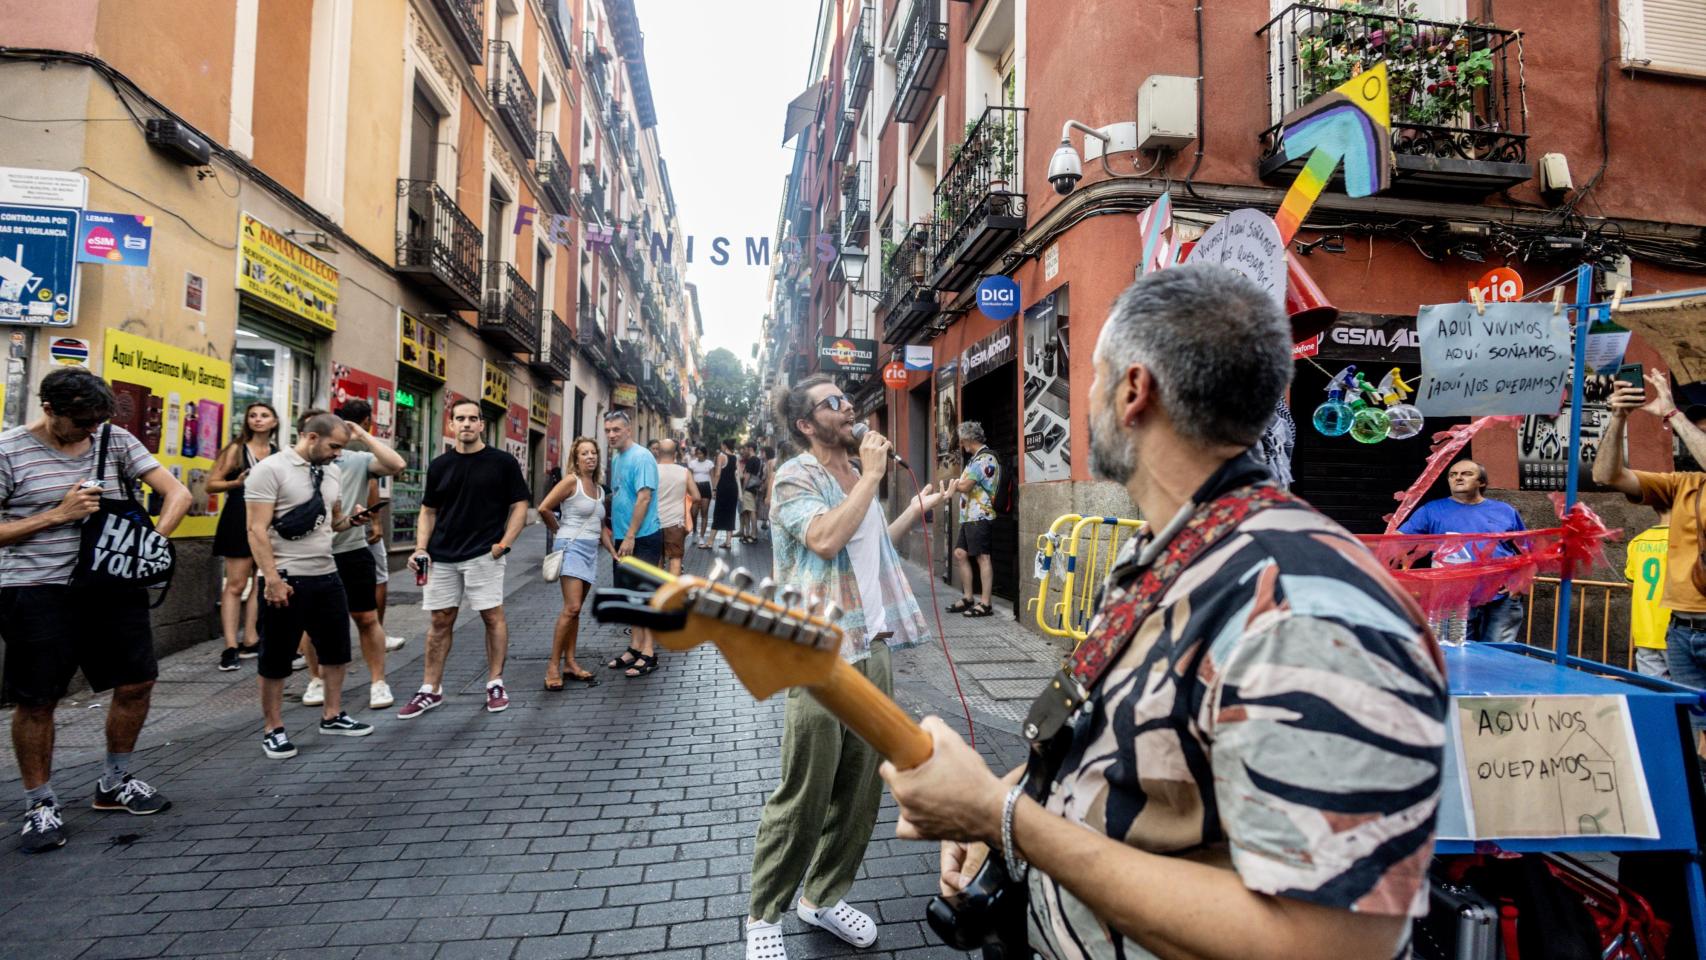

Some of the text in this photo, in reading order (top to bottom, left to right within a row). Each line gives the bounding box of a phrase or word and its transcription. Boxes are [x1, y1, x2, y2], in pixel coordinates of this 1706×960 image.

[1, 213, 68, 225] CONTROLADA POR
[86, 214, 114, 223] LEBARA
[13, 226, 24, 234] DE
[25, 227, 67, 237] VIGILANCIA
[87, 236, 115, 246] eSIM
[981, 289, 1014, 302] DIGI
[1438, 313, 1472, 338] AQUÍ
[112, 344, 226, 389] Aquí Vendemos Muy Baratos
[886, 364, 907, 379] ria
[1642, 557, 1661, 600] 9
[1479, 698, 1587, 736] AQUÍ NOS
[1477, 753, 1592, 782] QUEDAMOS
